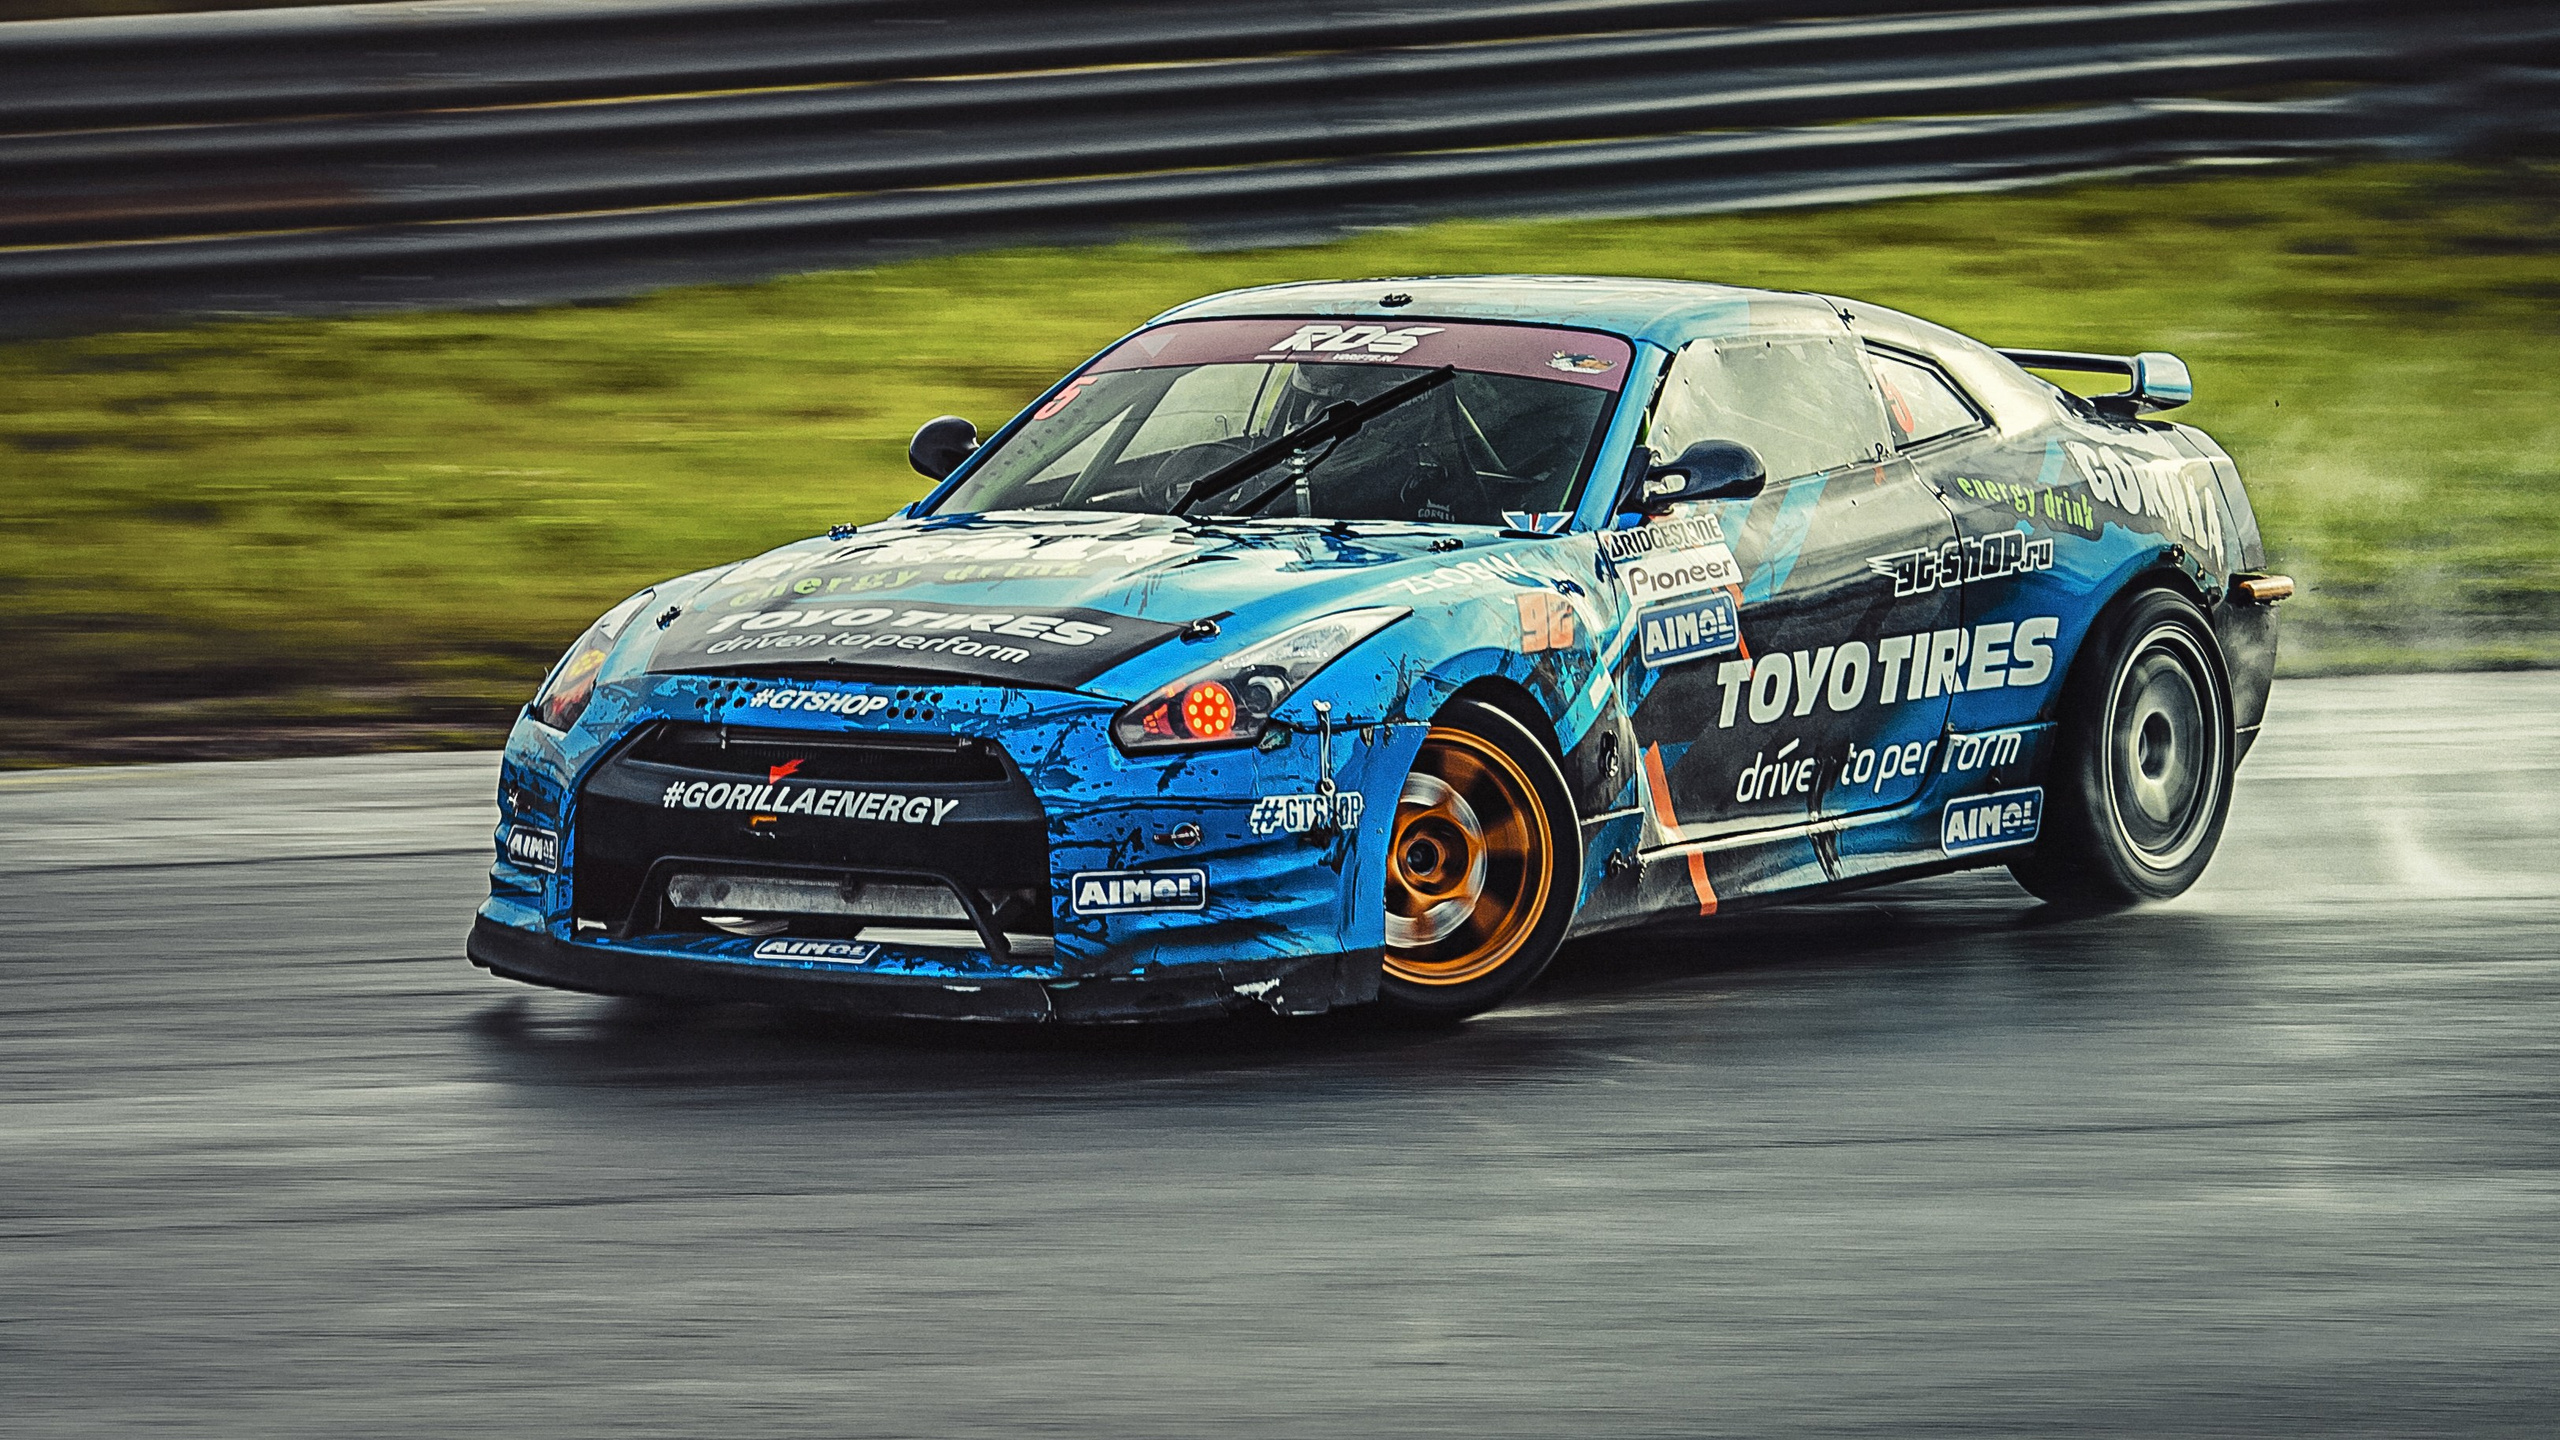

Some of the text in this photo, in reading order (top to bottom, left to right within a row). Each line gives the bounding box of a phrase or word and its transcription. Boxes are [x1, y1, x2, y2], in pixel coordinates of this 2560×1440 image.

[1269, 325, 1446, 354] RDS
[1957, 476, 2095, 532] energy drink
[2066, 441, 2225, 573] GORILLA
[729, 570, 922, 607] energy
[1628, 559, 1732, 597] Pioneer
[706, 607, 1112, 646] TOYO TIRES
[1646, 604, 1735, 656] AIMOL
[707, 630, 1031, 664] driven to perform
[1716, 616, 2059, 729] TOYO TIRES
[750, 688, 889, 716] #GTSHOP
[1736, 738, 1818, 803] drive
[662, 781, 960, 826] #GORILLAENERGY
[1945, 801, 2036, 844] AIMOL
[1078, 878, 1199, 906] AIMOL
[760, 941, 867, 957] AIMOL
